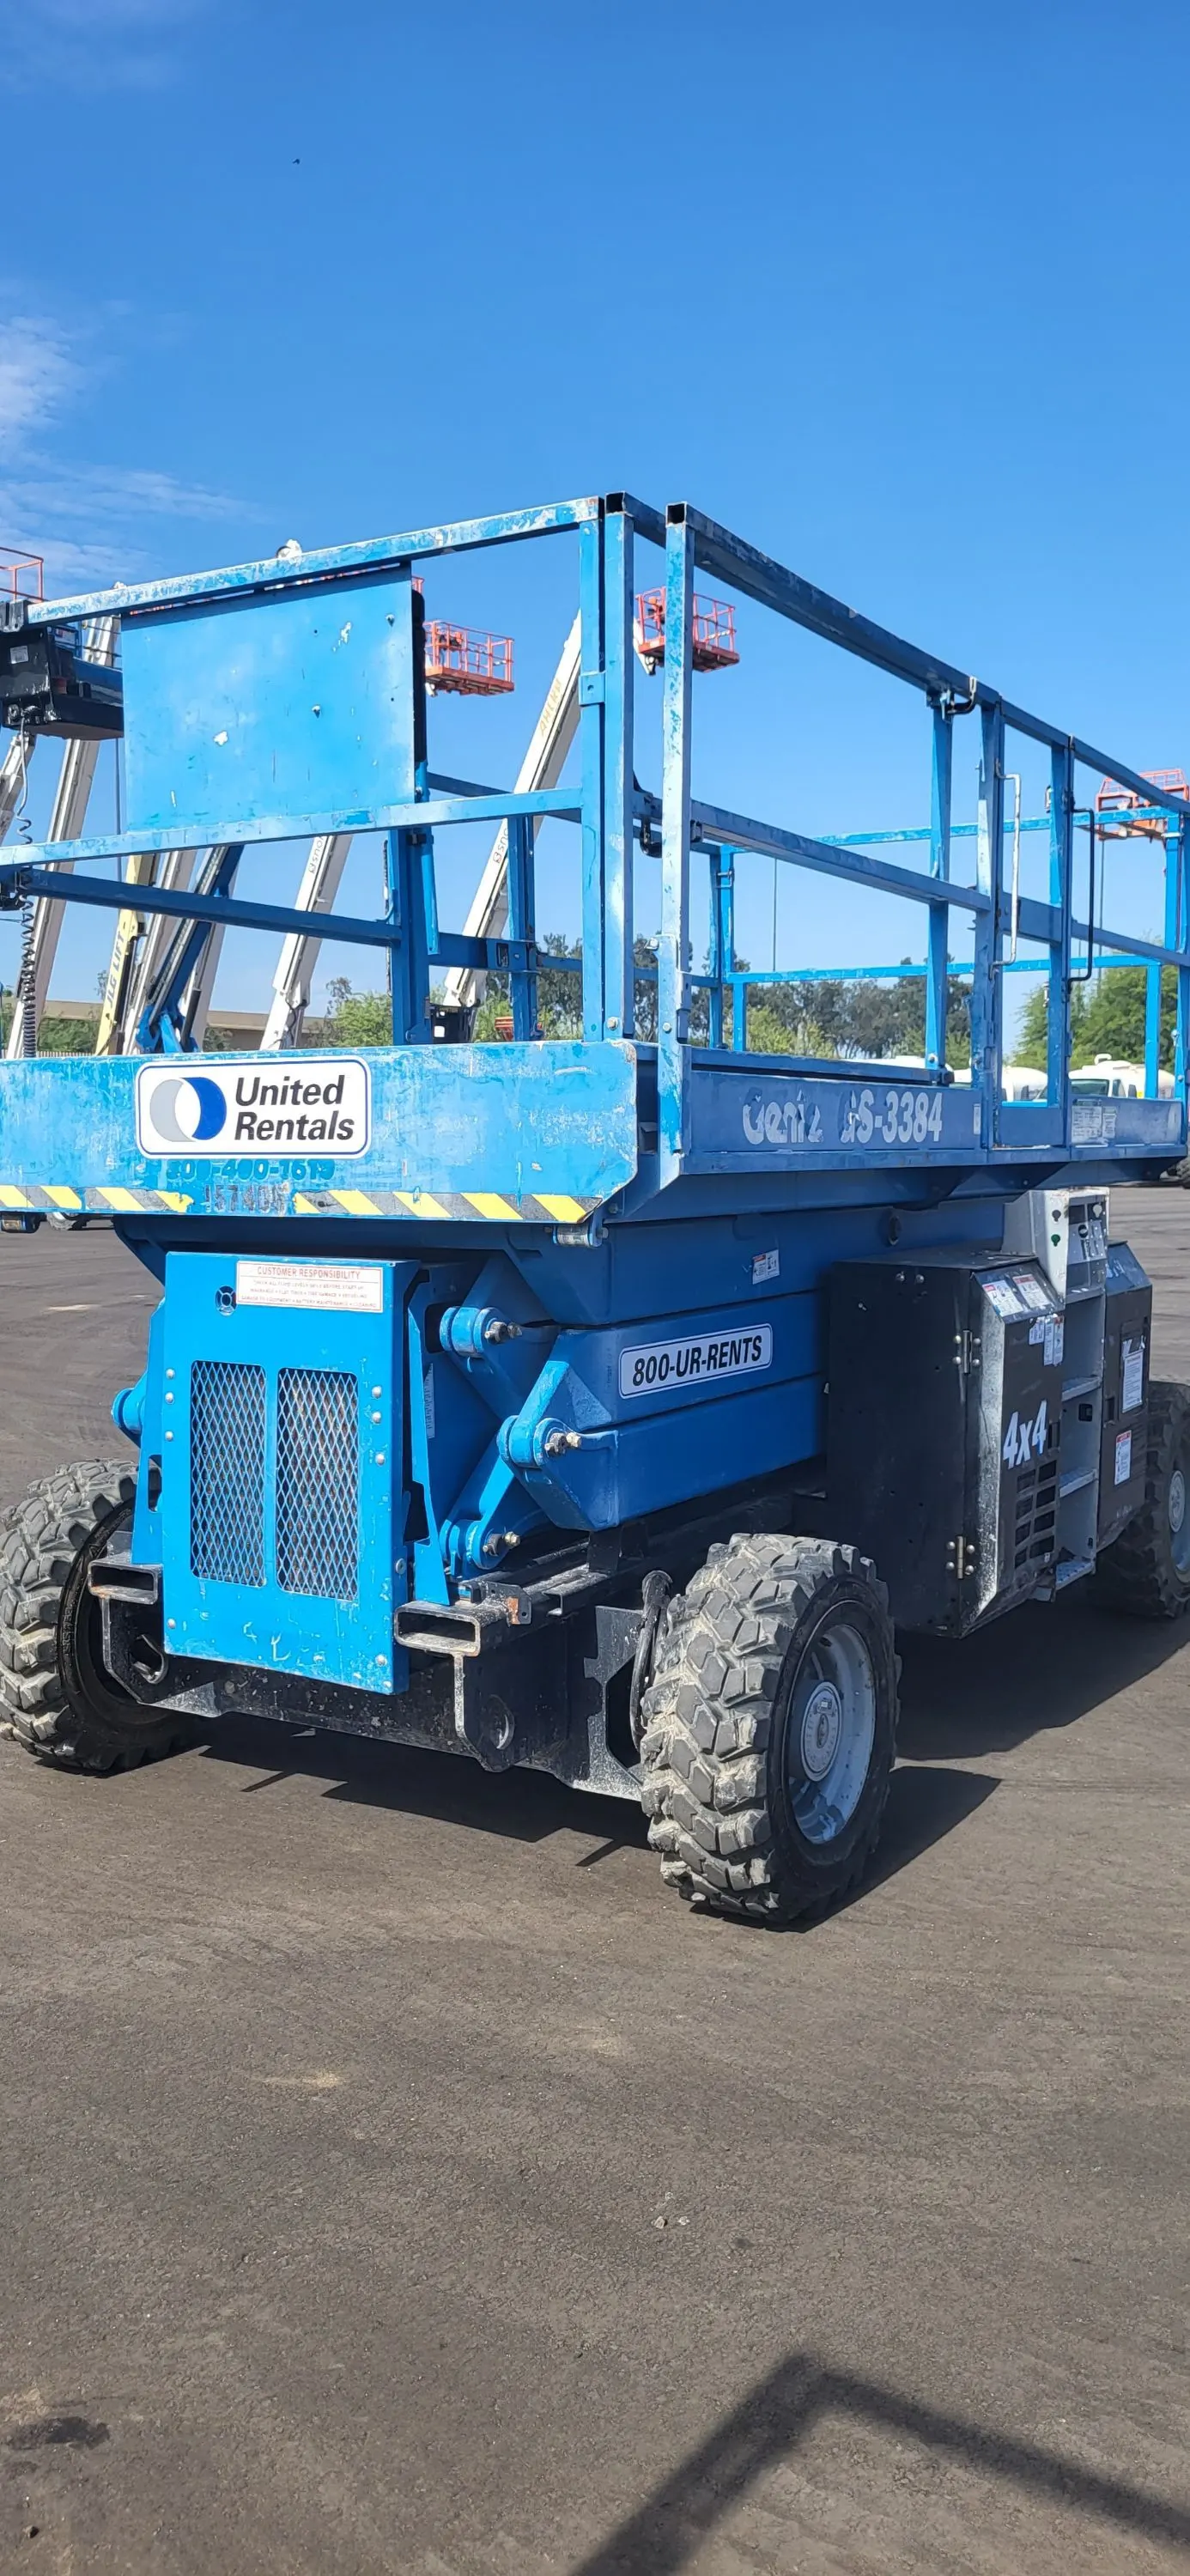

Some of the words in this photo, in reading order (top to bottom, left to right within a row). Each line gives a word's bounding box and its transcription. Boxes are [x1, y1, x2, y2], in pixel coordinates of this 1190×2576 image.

[107, 975, 117, 1008] JLG
[113, 931, 124, 972] LIFT
[235, 1074, 345, 1107] United
[234, 1109, 355, 1141] Rentals
[257, 1266, 297, 1278] CUSTOMER
[299, 1268, 361, 1279] RESPONSIBILITY
[632, 1334, 762, 1388] 800-UR-RENTS
[1002, 1399, 1047, 1470] 4x4
